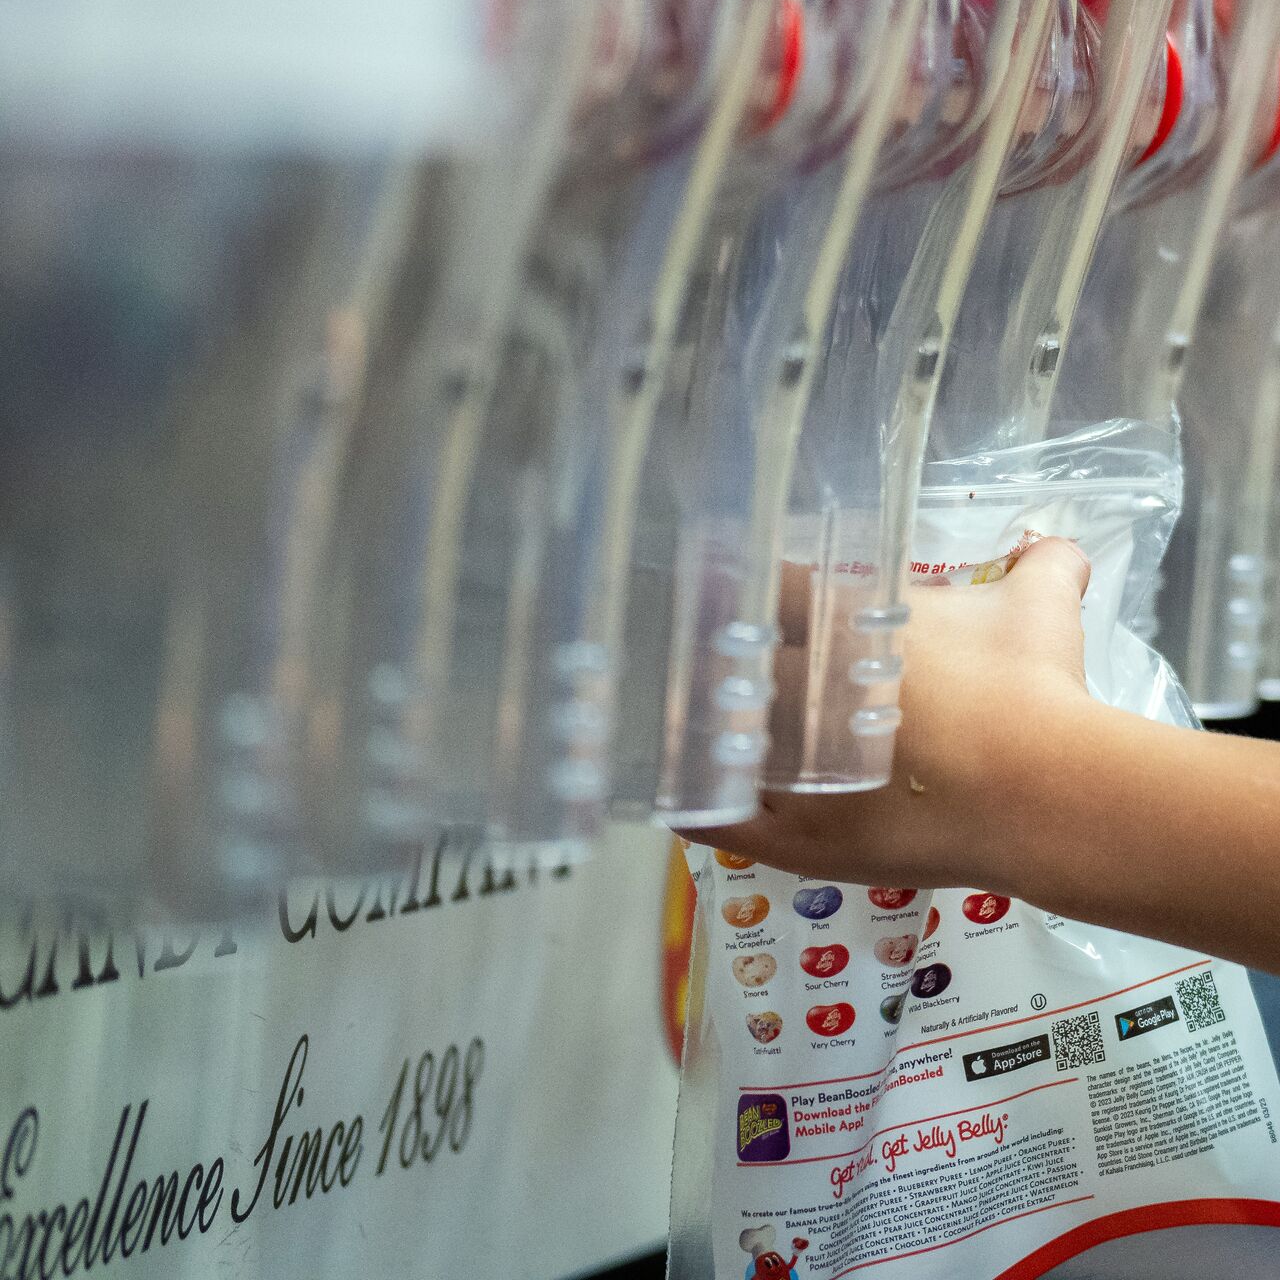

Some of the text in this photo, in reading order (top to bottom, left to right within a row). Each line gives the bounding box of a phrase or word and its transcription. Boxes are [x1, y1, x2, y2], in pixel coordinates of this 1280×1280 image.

[931, 561, 946, 575] at
[726, 872, 756, 882] Mimosa
[870, 910, 920, 923] Pomegranate
[963, 921, 1020, 940] Strawberry Jam
[725, 938, 776, 951] Pink Grapefruit
[805, 979, 849, 991] Sour Cherry
[922, 996, 960, 1009] Blackberry
[920, 1004, 1019, 1034] Naturally & Artificially Flavored
[1137, 1008, 1175, 1028] Google Play
[810, 1038, 856, 1050] Very Cherry
[991, 1046, 1022, 1058] Download
[1030, 1039, 1041, 1048] the
[993, 1048, 1043, 1071] App Store
[791, 1094, 815, 1107] Play
[899, 1048, 953, 1070] anywhere!
[1097, 1087, 1155, 1107] 2023 Jelly Belly Candy
[793, 1104, 852, 1123] Download
[855, 1102, 871, 1114] the
[1120, 1110, 1134, 1119] 2023
[231, 1033, 364, 1223] Since
[375, 1036, 486, 1177] 1898
[795, 1116, 864, 1137] Mobile App!
[913, 1125, 956, 1158] Jelly
[1094, 1133, 1113, 1142] Google
[741, 1209, 752, 1218] We
[752, 1210, 773, 1218] create
[775, 1208, 787, 1216] our
[789, 1205, 816, 1215] famous
[879, 1176, 891, 1186] the
[892, 1171, 914, 1180] finest
[915, 1162, 956, 1176] ingredients
[957, 1156, 976, 1166] from
[976, 1148, 999, 1161] around
[1000, 1144, 1010, 1152] the
[1011, 1135, 1030, 1147] world
[1030, 1127, 1064, 1141] including:
[786, 1217, 818, 1229] BANANA
[819, 1213, 840, 1224] PUREE
[869, 1189, 891, 1202] PUREE
[898, 1178, 938, 1193] BLUEBERRY
[939, 1172, 963, 1184] PUREE
[969, 1163, 993, 1176] LEMON
[993, 1154, 1012, 1167] PUREE
[1018, 1143, 1047, 1157] ORANGE
[1047, 1137, 1070, 1148] PUREE
[808, 1146, 1070, 1236] PEACH PUREE STRAWBERRY PUREE APPLE JUICE CONCENTRATE
[860, 1204, 908, 1224] CONCENTRATE
[914, 1192, 959, 1208] GRAPEFRUIT
[959, 1184, 978, 1195] JUICE
[978, 1169, 1021, 1190] CONCENTRATE
[1026, 1162, 1044, 1172] KIWI
[1045, 1157, 1064, 1167] JUICE
[872, 1218, 892, 1229] JUICE
[893, 1205, 945, 1223] CONCENTRATE
[951, 1195, 978, 1209] MANGO
[978, 1188, 994, 1200] JUICE
[995, 1171, 1040, 1191] CONCENTRATE
[1046, 1162, 1077, 1175] PASSION
[805, 1253, 826, 1263] FRUIT
[883, 1223, 904, 1235] PEAR
[904, 1218, 924, 1230] JUICE
[924, 1205, 974, 1224] CONCENTRATE
[978, 1190, 1009, 1207] PINEAPPLE
[1010, 1184, 1029, 1195] JUICE
[1029, 1171, 1079, 1188] CONCENTRATE
[864, 1230, 916, 1249] CONCENTRATE
[922, 1218, 962, 1235] TANGERINE
[962, 1212, 979, 1224] JUICE
[979, 1195, 1024, 1215] CONCENTRATE
[1029, 1180, 1079, 1198] WATERMELON
[894, 1234, 937, 1251] CHOCOLATE
[943, 1222, 974, 1239] COCONUT
[974, 1213, 996, 1227] FLAKES
[1001, 1202, 1025, 1215] COFFEE
[1026, 1194, 1056, 1208] EXTRACT
